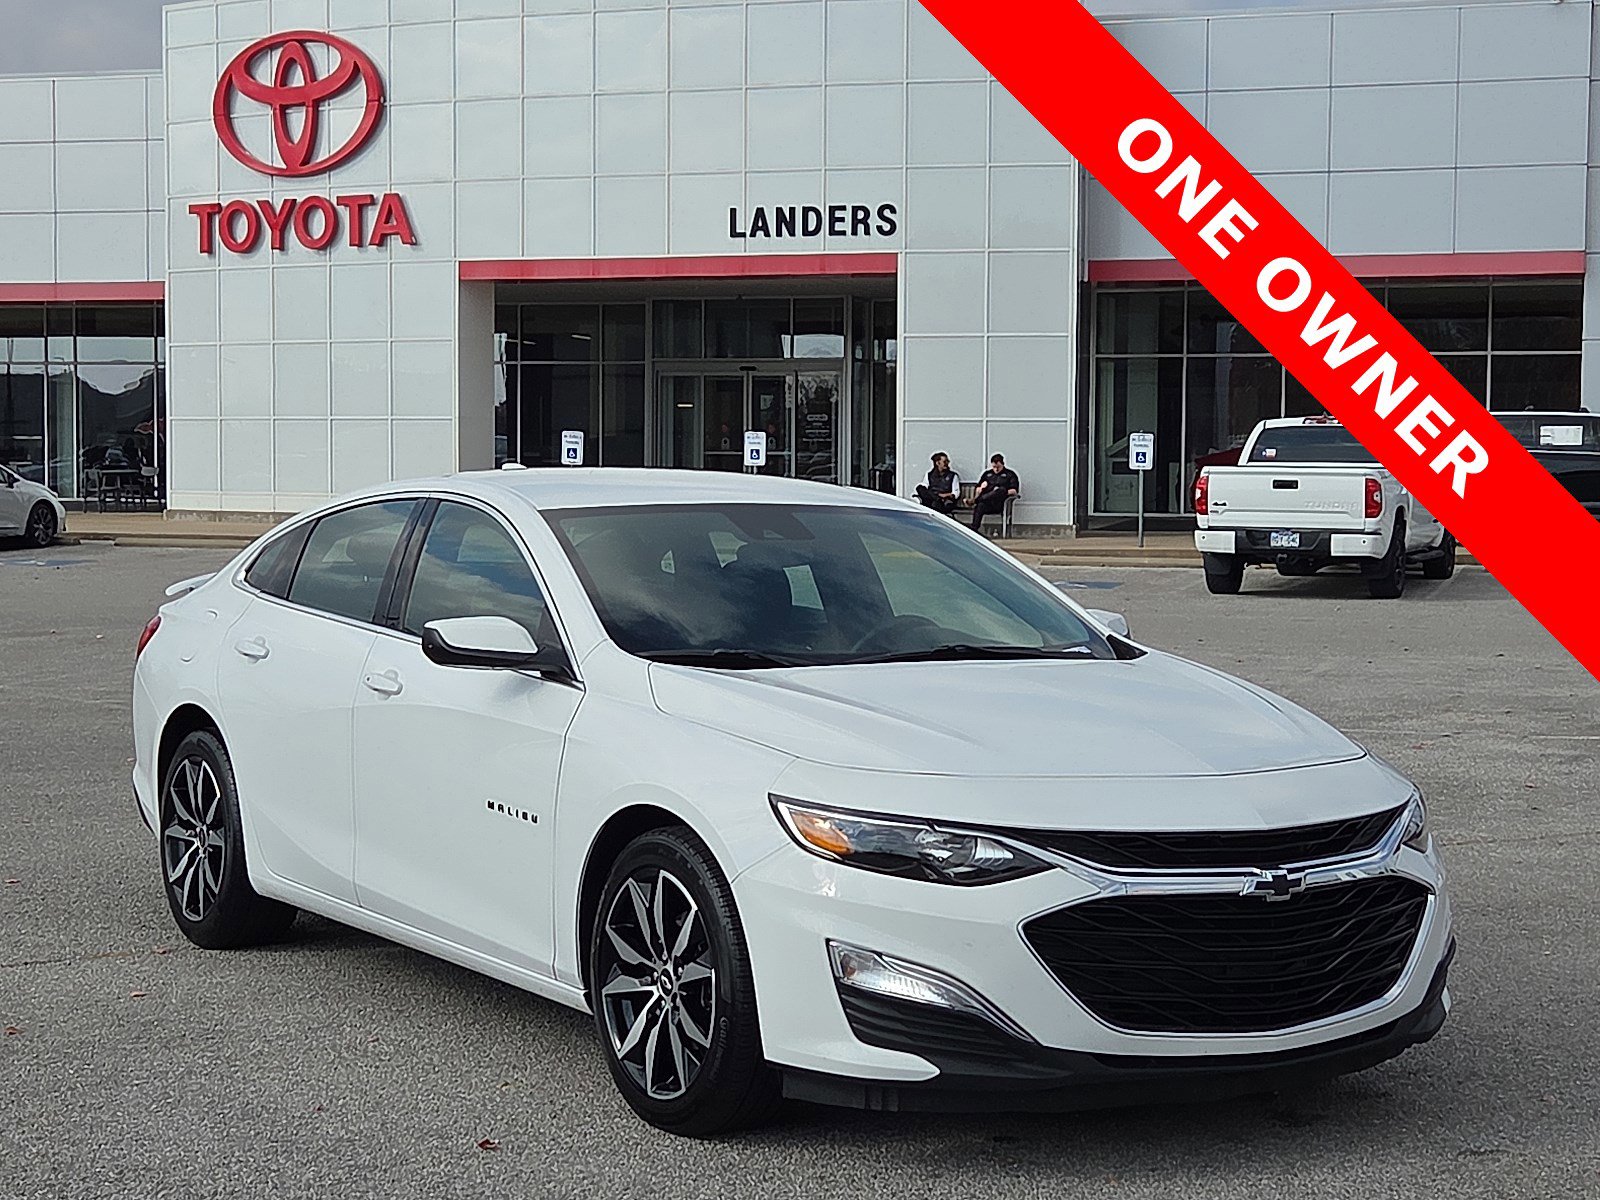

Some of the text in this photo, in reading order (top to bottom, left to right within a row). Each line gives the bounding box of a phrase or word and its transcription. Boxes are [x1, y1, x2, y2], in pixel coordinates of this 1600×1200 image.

[189, 192, 417, 254] TOYOTA
[729, 203, 898, 238] LANDERS
[487, 800, 538, 824] MALIBU
